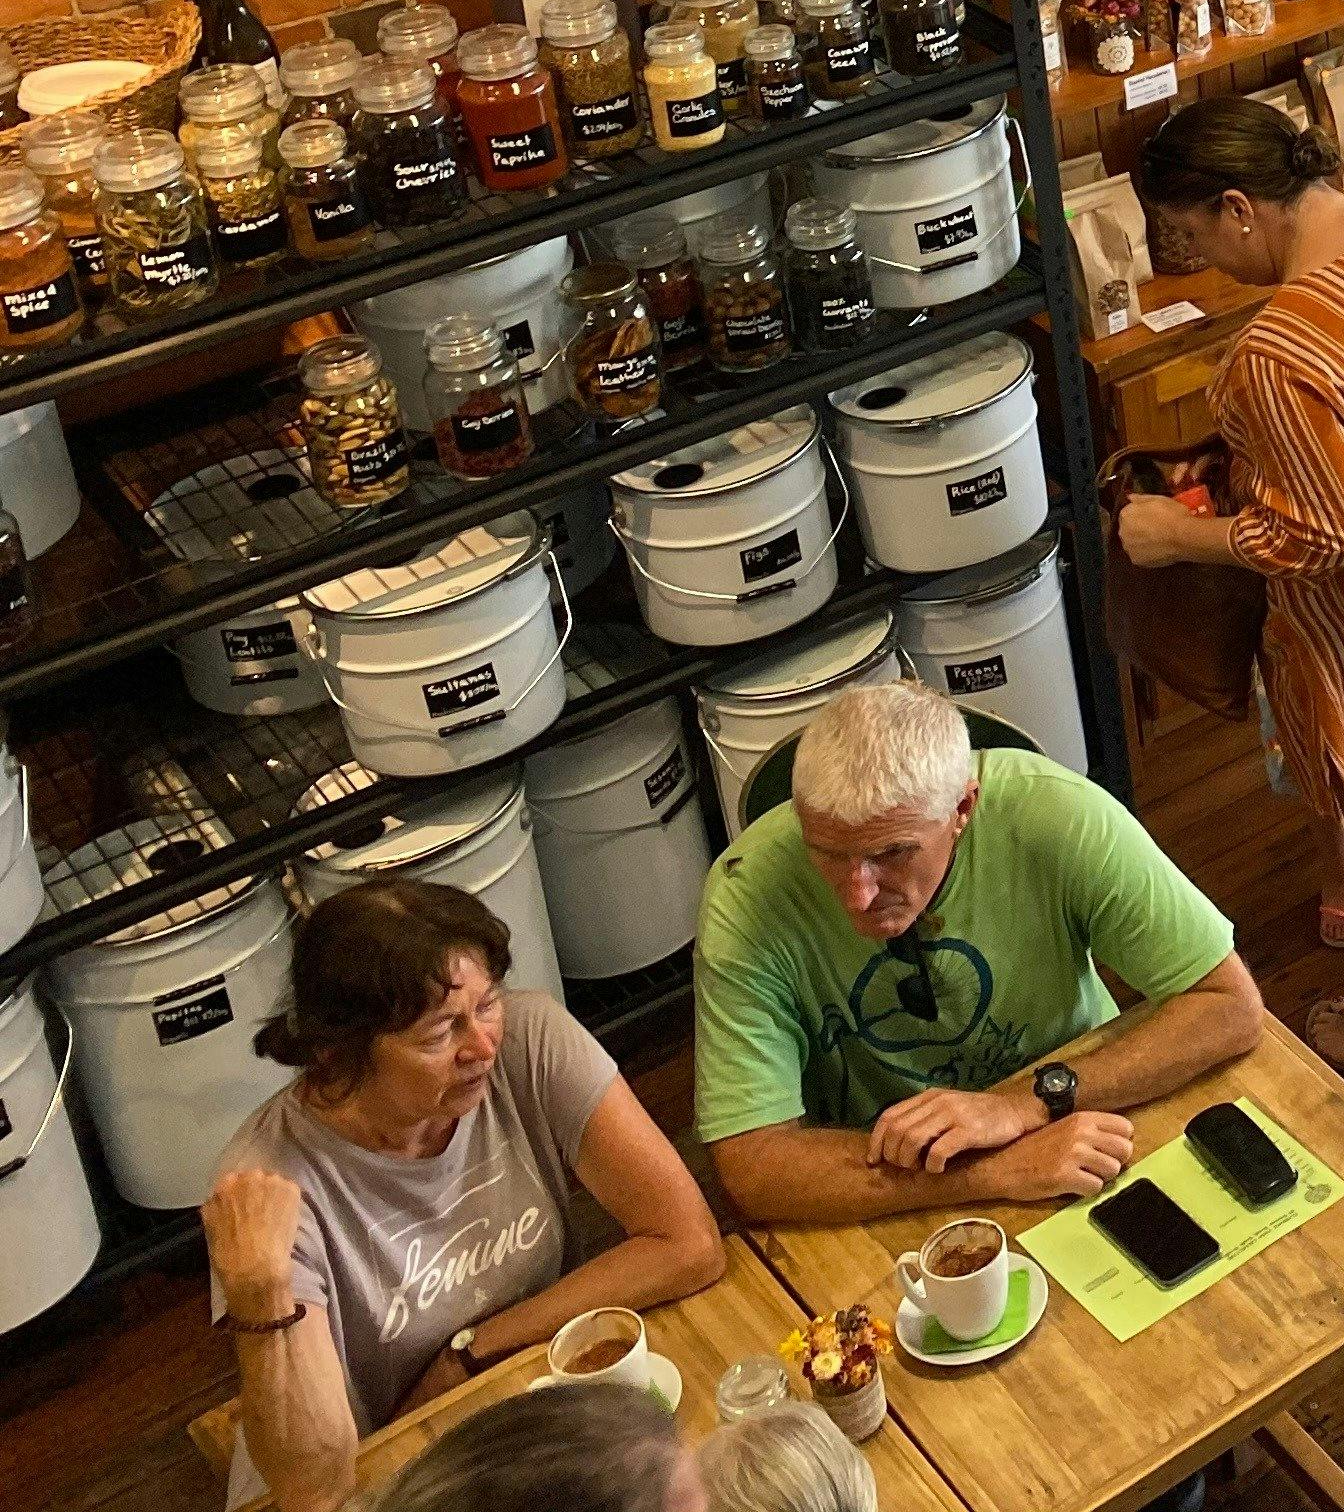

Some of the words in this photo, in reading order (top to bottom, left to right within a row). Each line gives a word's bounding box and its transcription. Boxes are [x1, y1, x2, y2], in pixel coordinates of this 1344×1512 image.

[572, 97, 630, 118] Coriander
[490, 134, 531, 148] Sweet
[492, 148, 545, 167] Paprika
[315, 202, 355, 220] Vanilla
[9, 299, 50, 318] Spice
[427, 670, 492, 696] Sultanas
